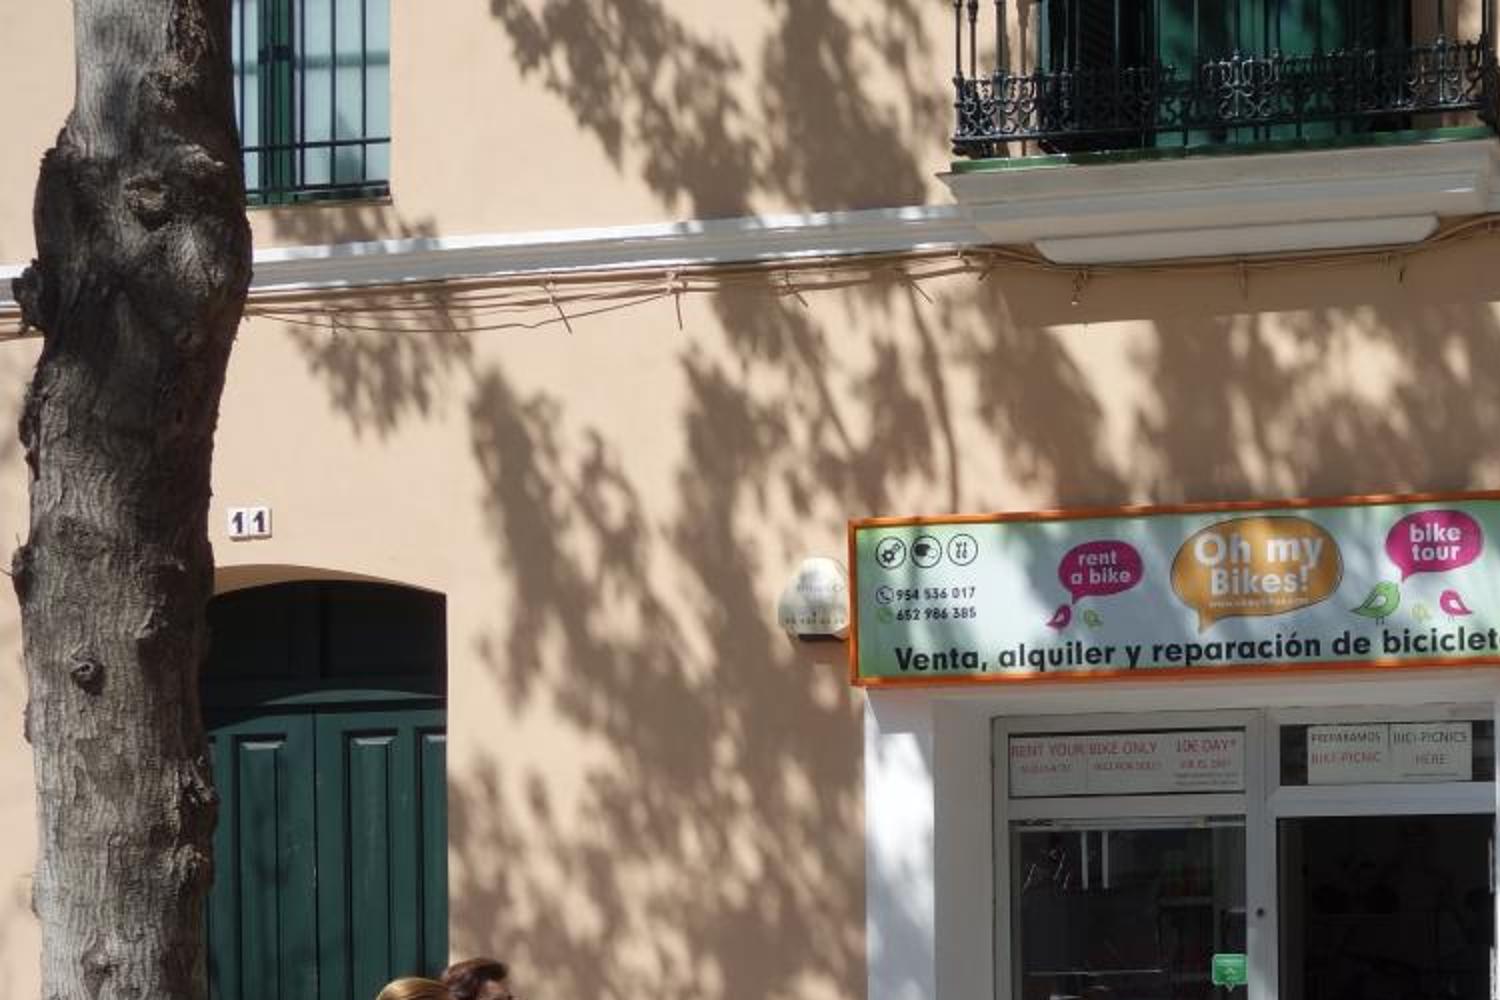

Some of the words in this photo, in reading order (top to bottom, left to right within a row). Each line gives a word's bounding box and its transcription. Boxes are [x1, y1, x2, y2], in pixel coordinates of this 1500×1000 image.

[231, 510, 265, 534] 11
[1409, 523, 1461, 543] bike
[1077, 551, 1117, 567] rent
[1193, 532, 1250, 566] Oh
[1265, 535, 1323, 569] my
[1411, 544, 1461, 561] tour
[1071, 571, 1082, 585] a
[1088, 567, 1131, 585] bike
[1210, 564, 1309, 596] Bikes!
[896, 588, 919, 601] 954
[924, 587, 948, 600] 536
[952, 586, 976, 599] 017
[896, 609, 921, 621] 652
[924, 608, 949, 620] 986
[952, 607, 977, 619] 385
[894, 647, 988, 672] Venta,
[998, 641, 1116, 672] alquiler
[1125, 645, 1141, 669] y
[1152, 632, 1321, 666] reparación
[1331, 630, 1371, 655] de
